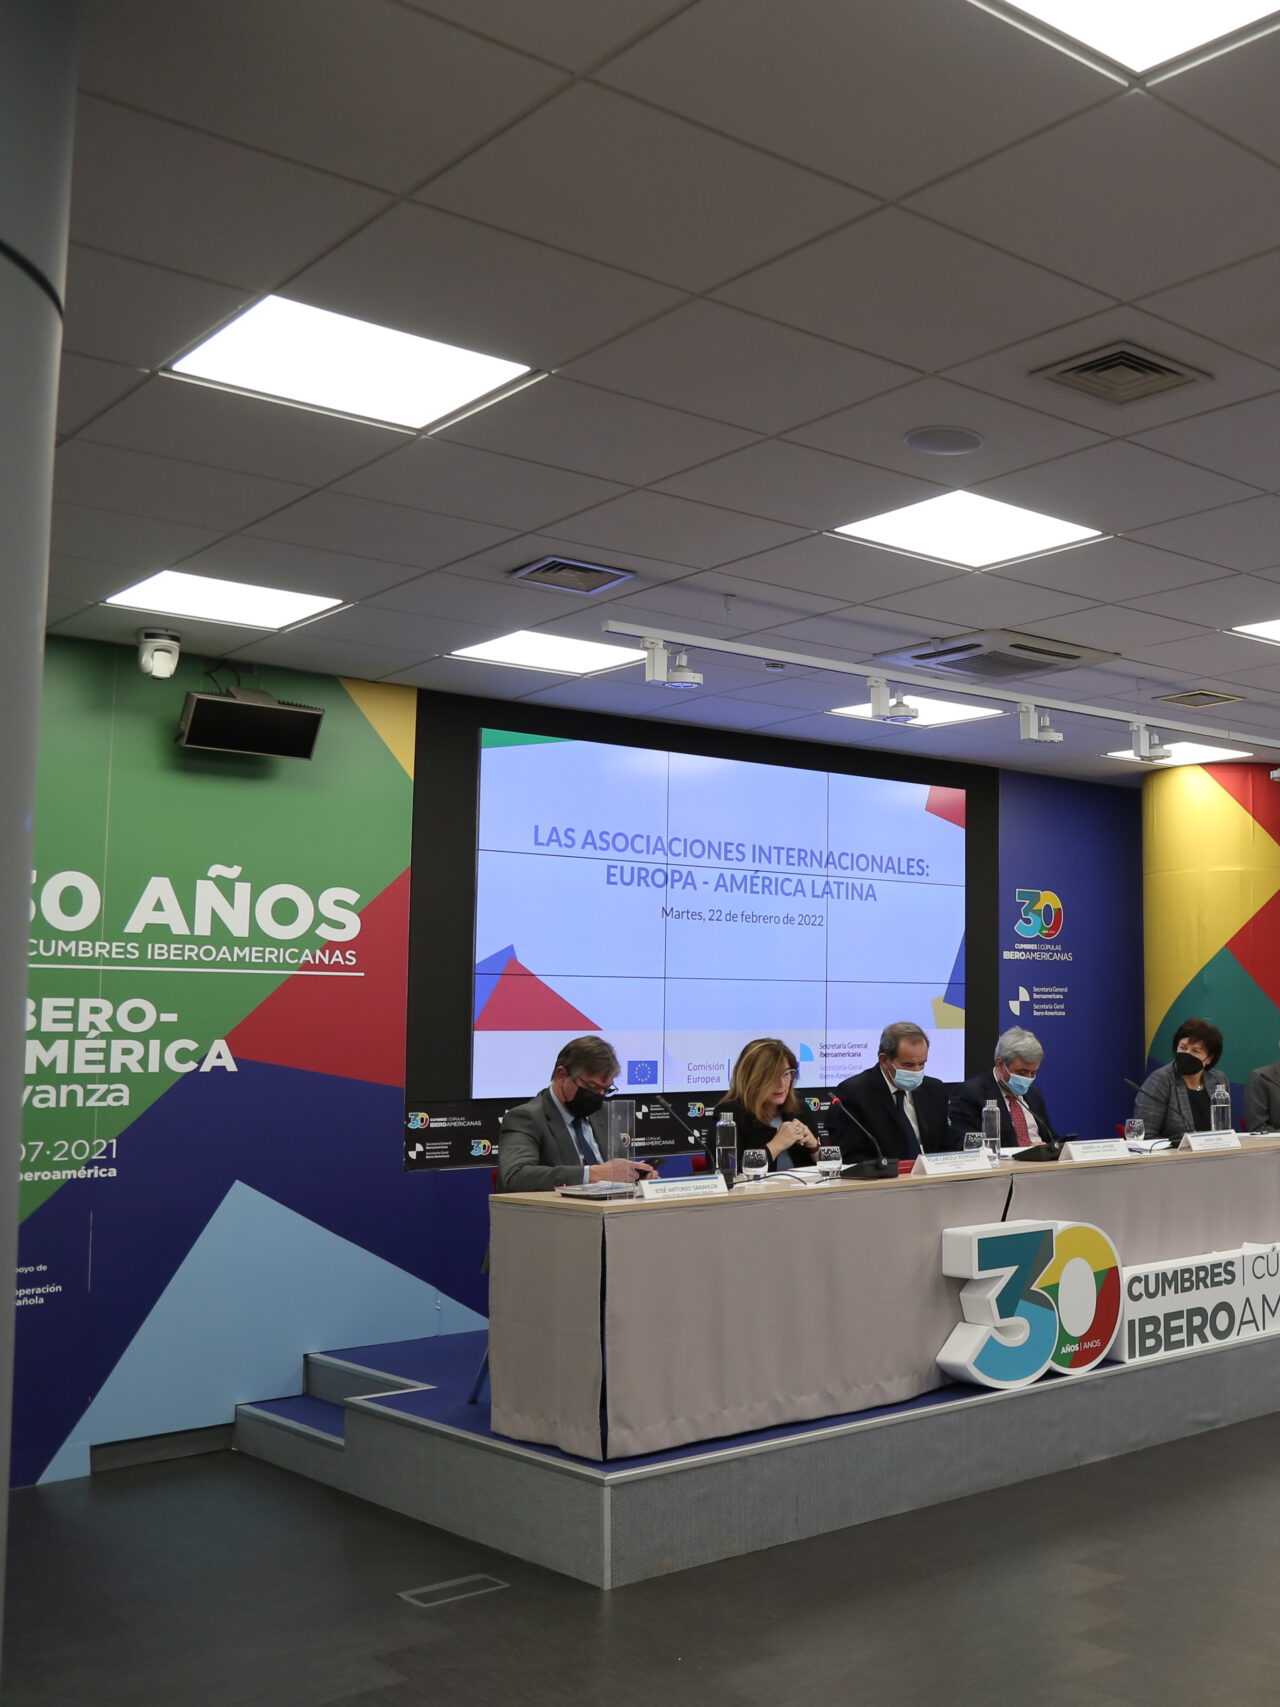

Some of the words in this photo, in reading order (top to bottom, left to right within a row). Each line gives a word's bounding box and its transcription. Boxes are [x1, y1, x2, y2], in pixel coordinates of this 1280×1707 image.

[533, 825, 576, 849] LAS
[581, 829, 746, 863] ASOCIACIONES
[752, 844, 930, 877] INTERNACIONALES:
[606, 864, 697, 891] EUROPA
[713, 870, 806, 898] AMÉRICA
[811, 879, 877, 902] LATINA
[123, 864, 361, 942] AÑOS
[661, 907, 706, 922] Martes,
[708, 909, 723, 921] 22
[725, 910, 739, 922] de
[741, 910, 780, 925] febrero
[782, 913, 795, 925] de
[798, 914, 824, 927] 2022
[1013, 888, 1064, 940] 30
[147, 943, 357, 965] IBEROAMERICANAS
[1040, 943, 1062, 951] CÚPULAS
[1003, 951, 1073, 961] IBEROAMERICANAS
[847, 1042, 868, 1050] General
[687, 1061, 725, 1072] Comisión
[687, 1075, 721, 1085] Europea
[407, 1112, 430, 1129] 30
[470, 1139, 492, 1156] 30
[36, 1264, 48, 1272] de
[1127, 1260, 1236, 1302] CUMBRES
[938, 1219, 1122, 1389] 30
[1060, 1342, 1080, 1355] AÑOS
[1082, 1338, 1101, 1349] ANOS
